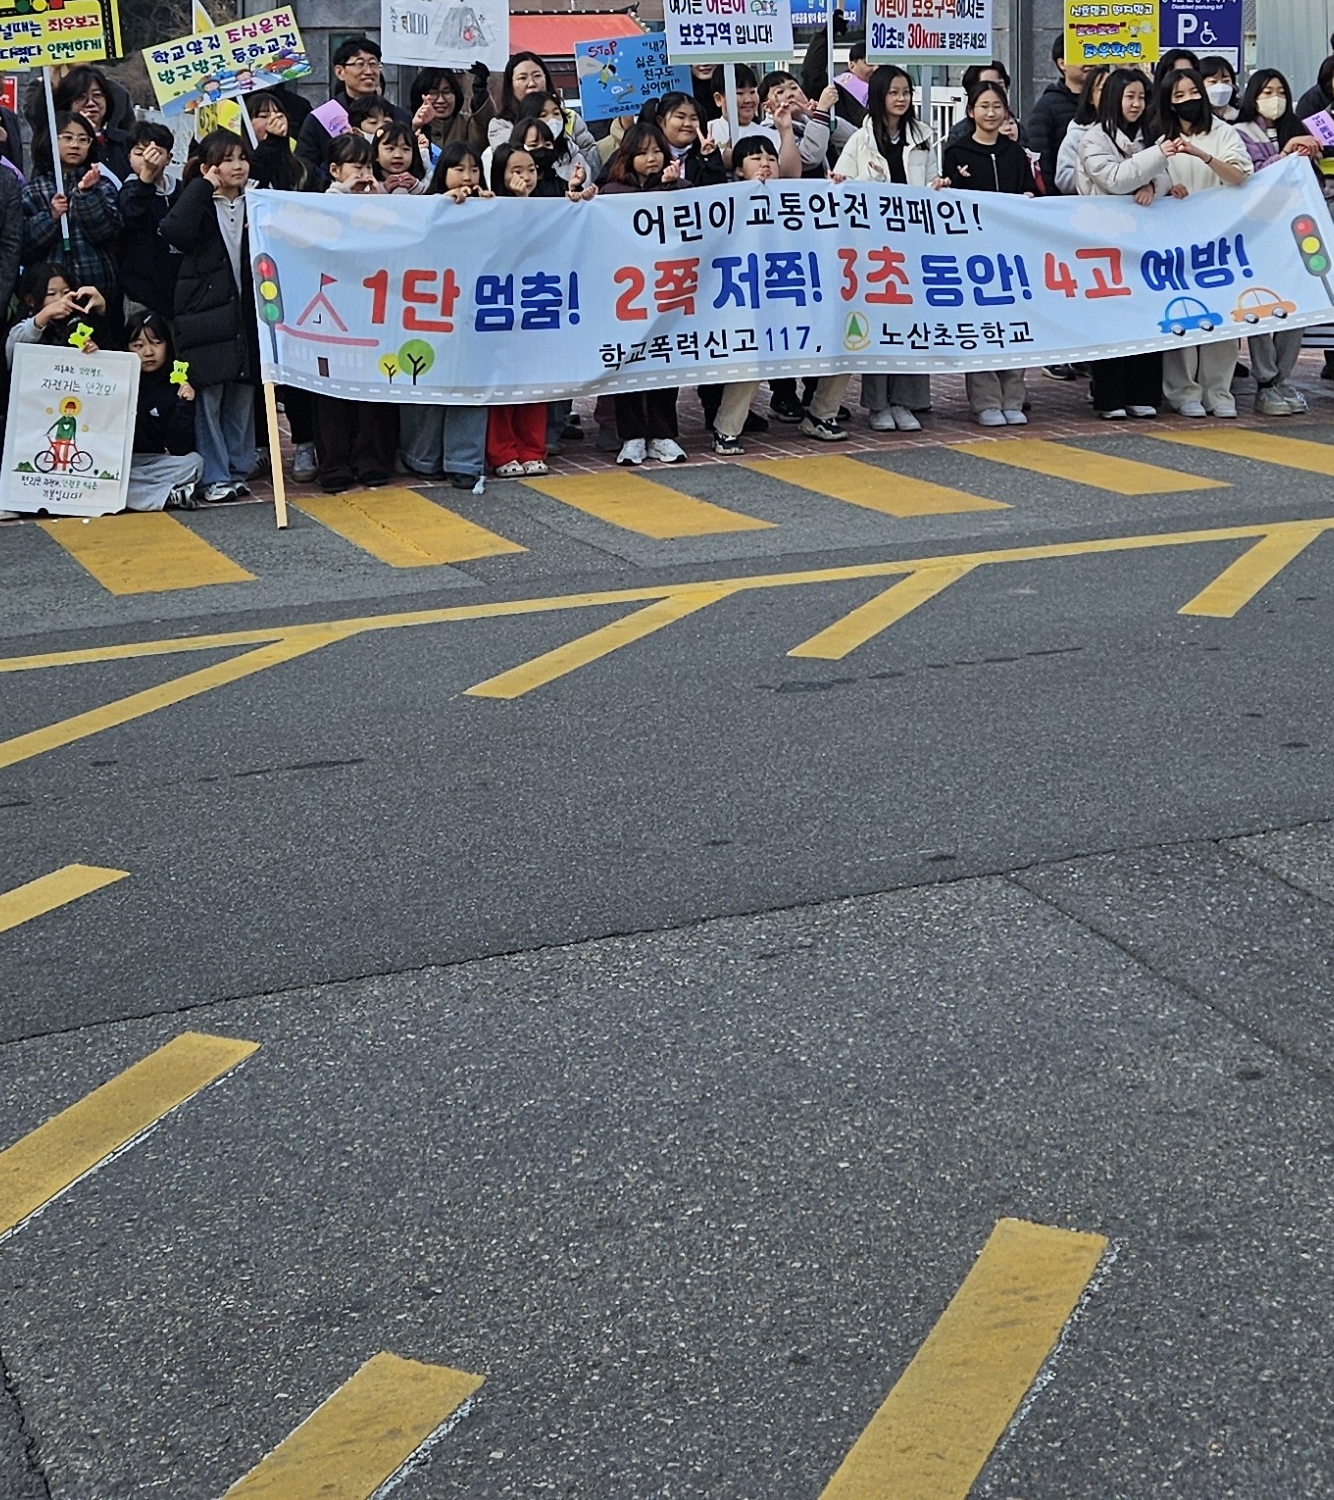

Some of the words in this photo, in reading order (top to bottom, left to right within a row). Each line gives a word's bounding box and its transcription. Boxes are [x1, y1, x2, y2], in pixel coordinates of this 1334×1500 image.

[46, 14, 100, 33] 좌우보고
[679, 22, 732, 46] 보호구역
[734, 24, 773, 45] 입니다!
[871, 22, 905, 50] 30초만
[907, 22, 947, 50] 30km로
[1177, 13, 1198, 44] P
[46, 38, 103, 61] 안전하게
[643, 66, 675, 81] 친구도
[632, 197, 735, 245] 어린이
[745, 191, 870, 231] 교통안전
[878, 195, 984, 236] 캠페인!
[362, 267, 461, 333] 1단
[473, 269, 581, 333] 멈춤!
[612, 256, 701, 322] 2쪽
[710, 250, 824, 311] 저쪽!
[836, 245, 915, 306] 3초
[920, 253, 1033, 307] 동안!
[1043, 247, 1132, 300] 4고
[1140, 232, 1254, 291] 예방!
[598, 326, 760, 372] 학교폭력신고
[765, 325, 823, 353] 117,
[878, 320, 1034, 351] 노산초등학교
[40, 378, 81, 393] 자전거는
